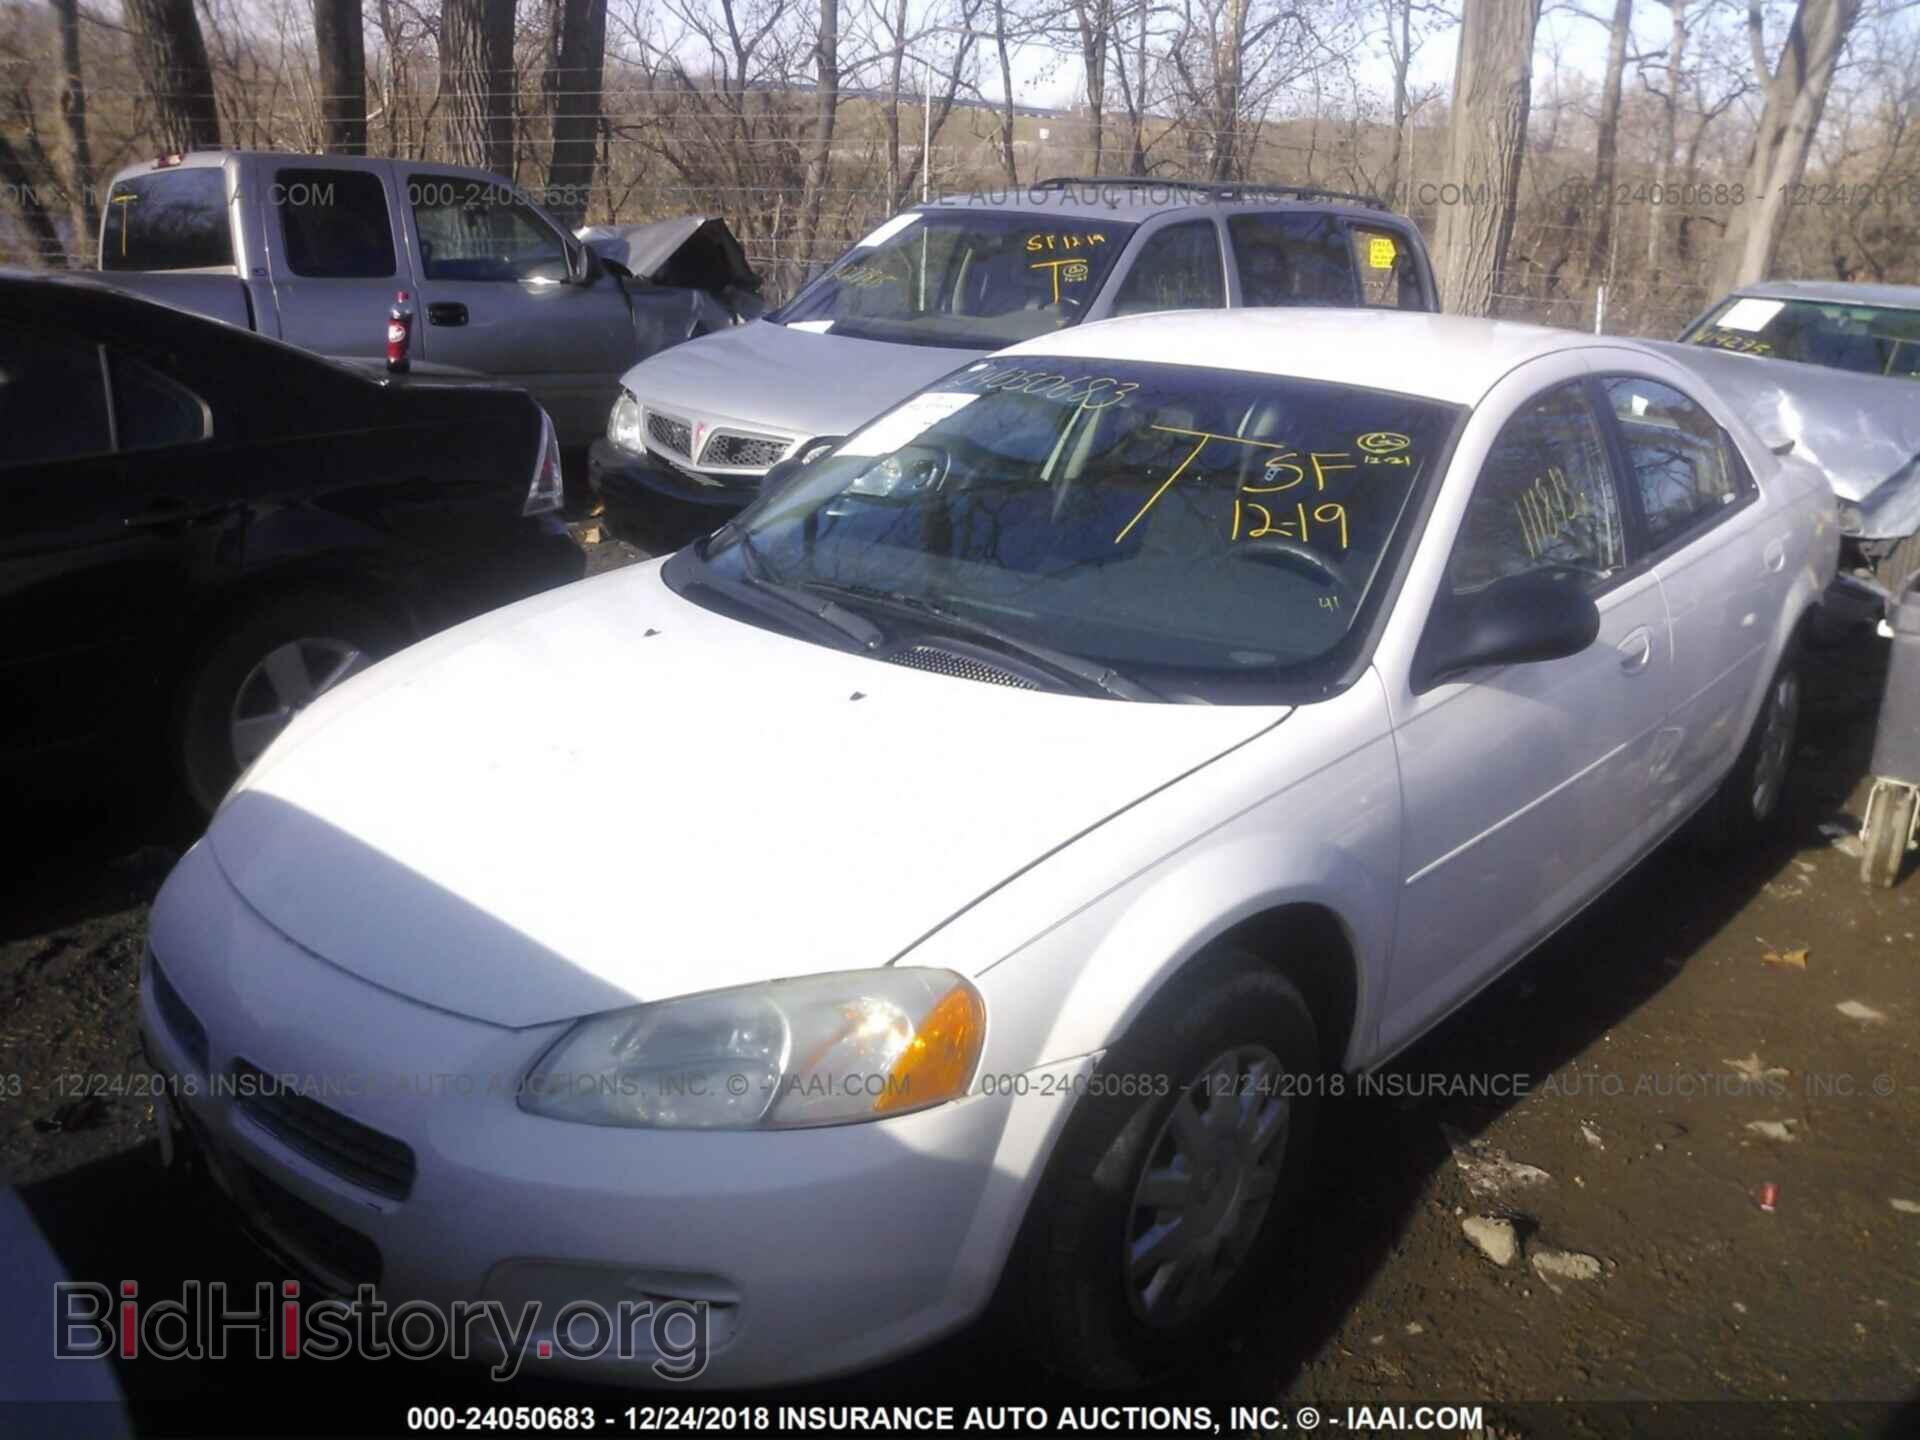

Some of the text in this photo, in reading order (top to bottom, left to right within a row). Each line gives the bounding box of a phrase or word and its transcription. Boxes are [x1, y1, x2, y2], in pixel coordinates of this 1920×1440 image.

[1031, 258, 1088, 305] T
[1115, 424, 1286, 544] T
[1231, 498, 1349, 549] 12-19
